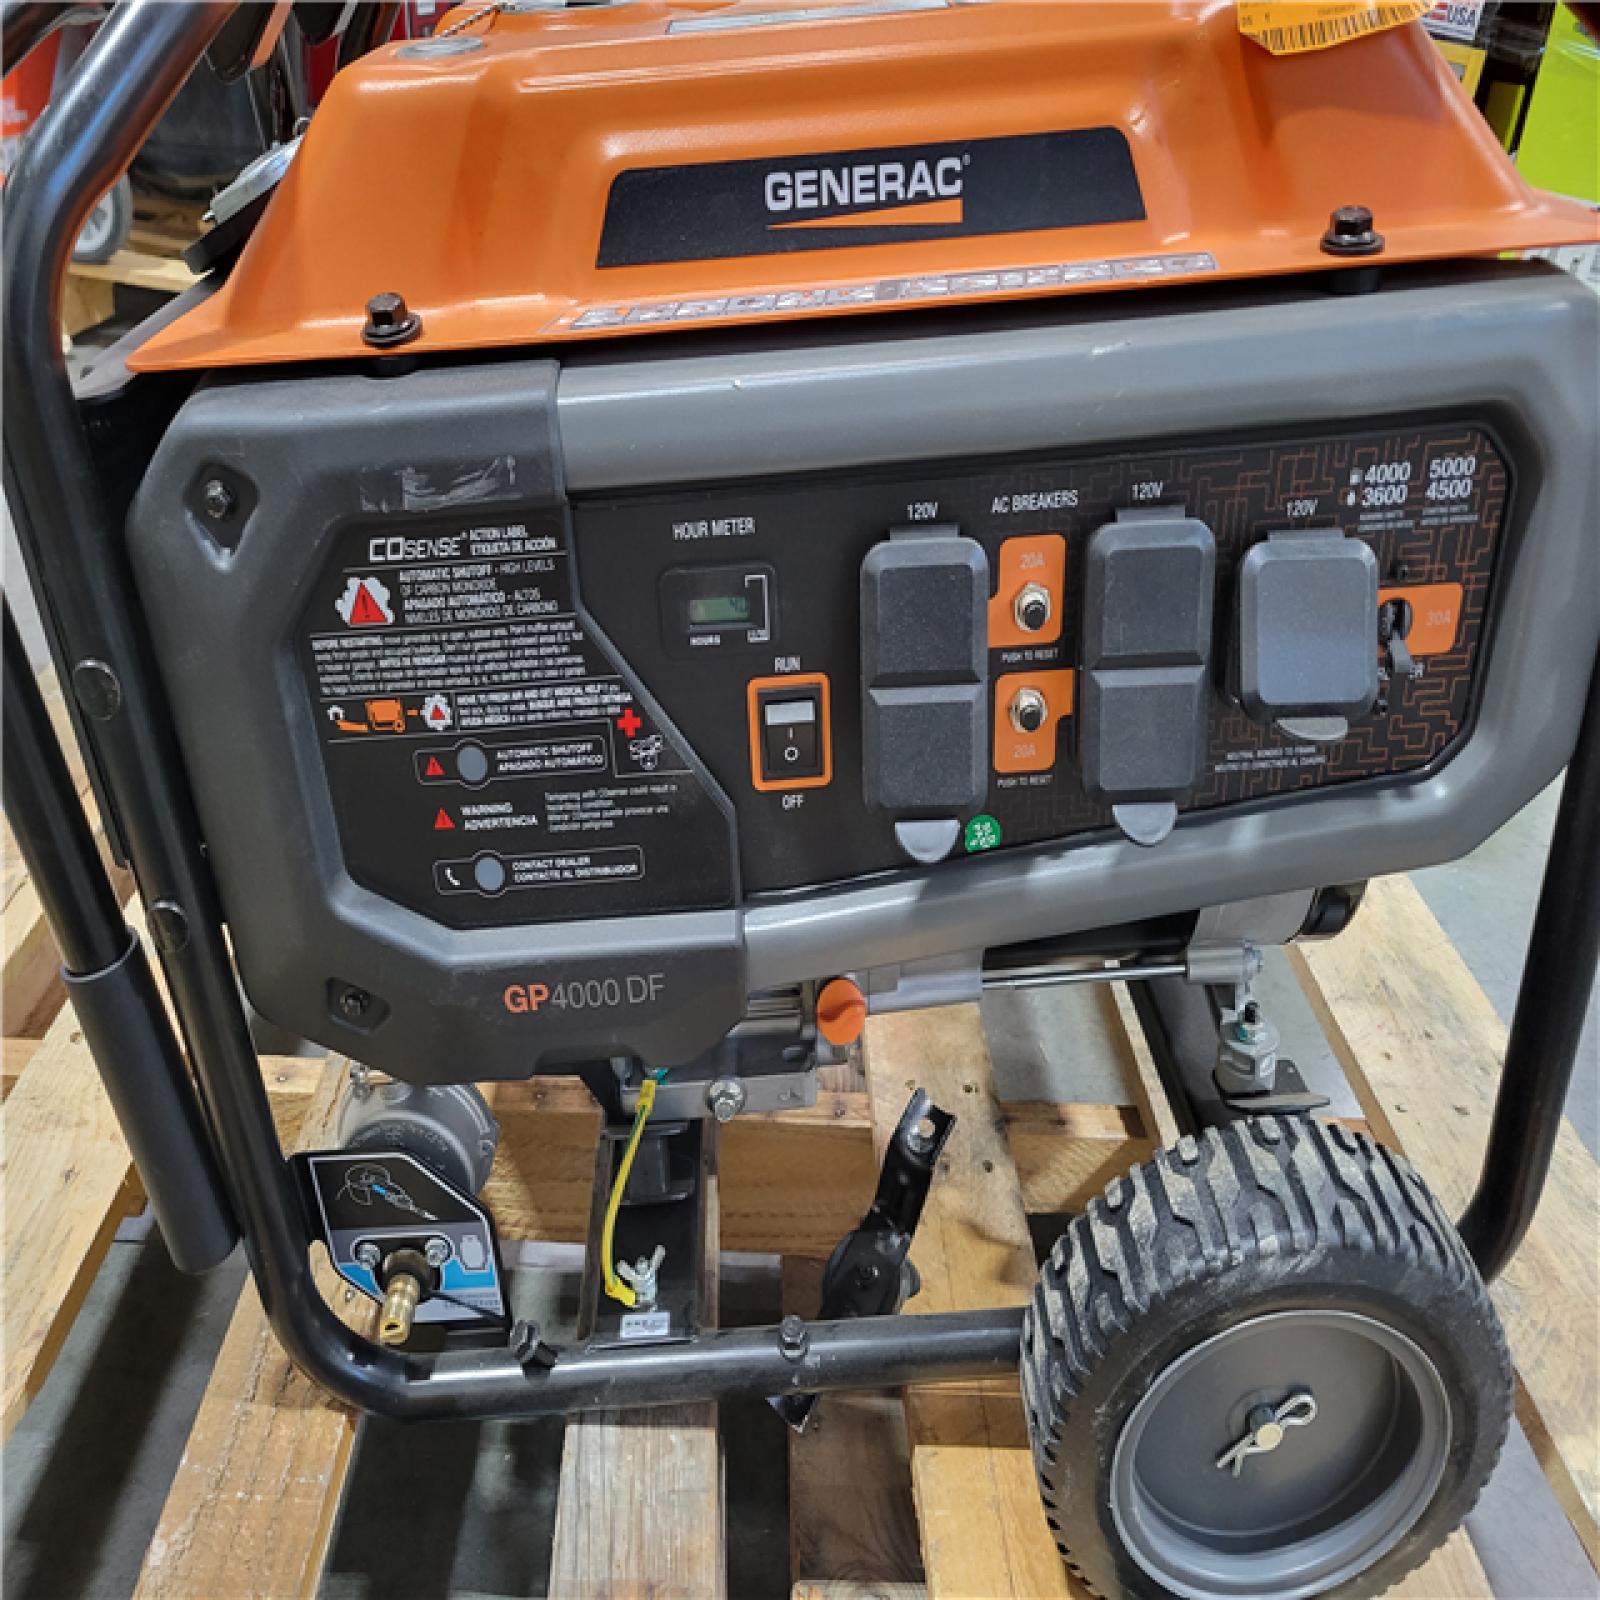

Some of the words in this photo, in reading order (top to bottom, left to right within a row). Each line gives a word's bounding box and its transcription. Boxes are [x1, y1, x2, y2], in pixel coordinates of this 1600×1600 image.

[765, 158, 963, 212] GENERAC
[1364, 462, 1411, 484] 4000
[1429, 455, 1476, 478] 5000
[991, 497, 1009, 514] AC
[1012, 490, 1079, 511] BREAKERS
[1132, 482, 1164, 499] 120V
[1361, 485, 1409, 507] 3600
[1426, 478, 1473, 500] 4500
[907, 502, 938, 520] 120V
[672, 521, 708, 540] HOUR
[712, 517, 755, 535] METER
[1020, 552, 1046, 570] 20A
[774, 657, 800, 672] RUN
[782, 794, 803, 810] OFF
[503, 979, 621, 1014] GP4000
[625, 972, 665, 1003] DF
